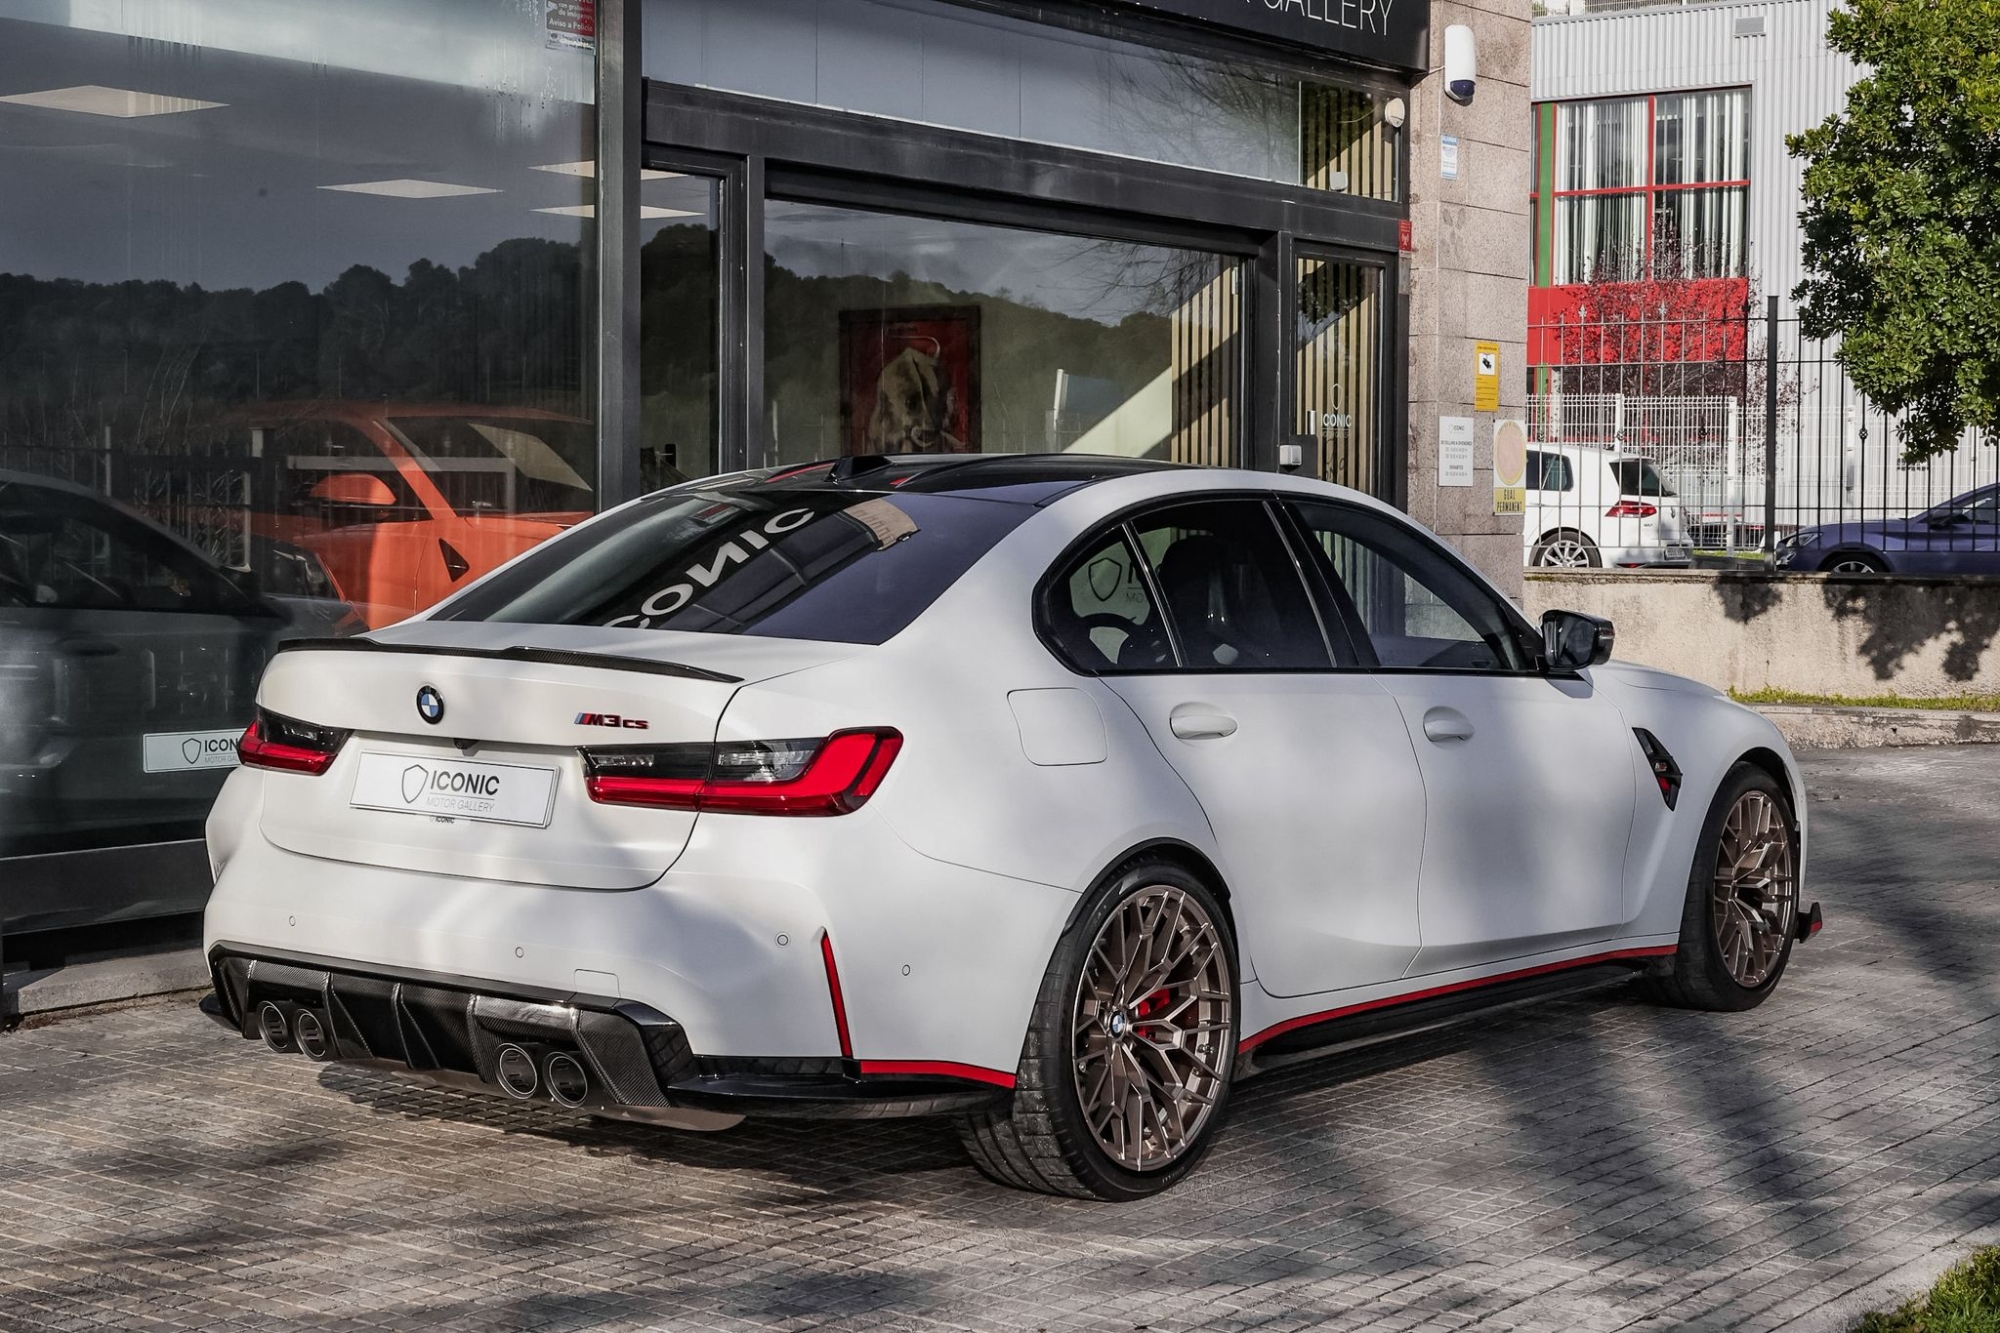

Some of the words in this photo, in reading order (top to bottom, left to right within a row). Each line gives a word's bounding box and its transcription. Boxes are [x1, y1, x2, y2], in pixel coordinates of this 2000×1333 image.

[549, 18, 567, 28] Aviso
[1264, 0, 1393, 36] LLERY
[1320, 413, 1352, 428] ICONIC
[1496, 501, 1522, 512] PERMANENT
[205, 738, 238, 752] ICON
[430, 770, 500, 796] ICONIC
[426, 797, 456, 809] MOTOR
[457, 799, 495, 813] GALLERY
[435, 815, 456, 825] ICONIC
